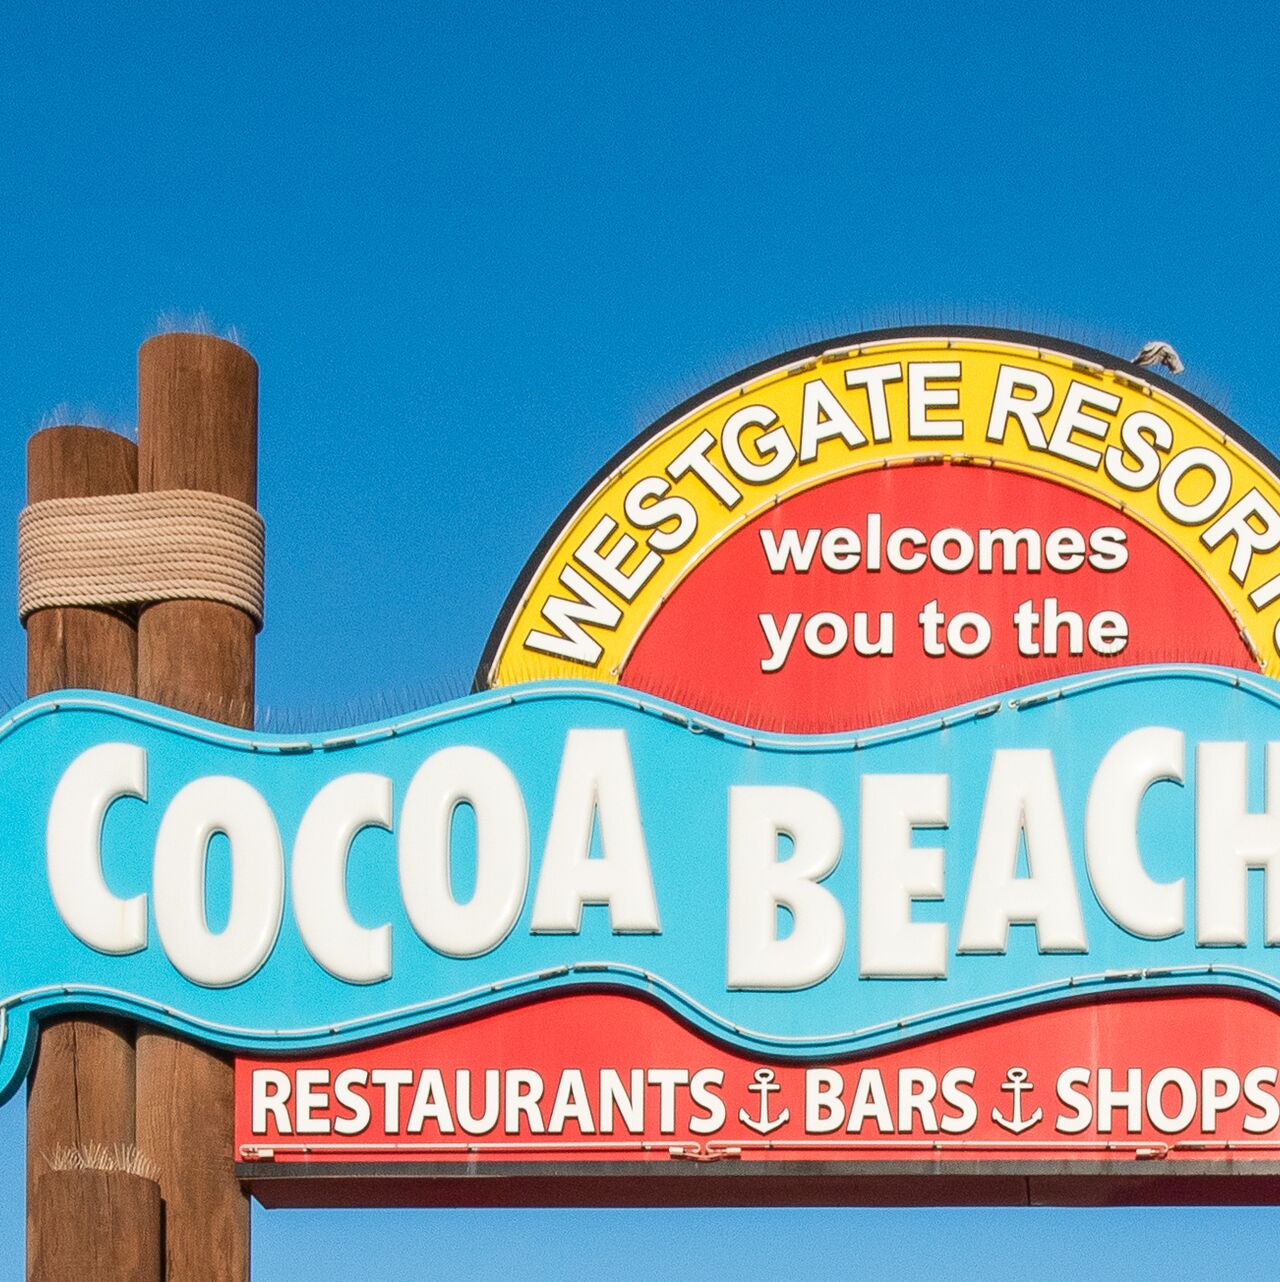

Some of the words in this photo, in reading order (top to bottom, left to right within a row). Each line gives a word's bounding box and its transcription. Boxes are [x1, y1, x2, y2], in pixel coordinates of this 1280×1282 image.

[524, 360, 964, 668] WESTGATE
[758, 514, 1129, 575] welcomes
[758, 608, 895, 675] you
[919, 598, 990, 656] to
[1014, 597, 1129, 657] the
[45, 727, 662, 989] COCOA
[250, 1067, 726, 1138] RESTAURANTS
[805, 1066, 979, 1137] BARS
[1055, 1065, 1280, 1135] SHOPS
